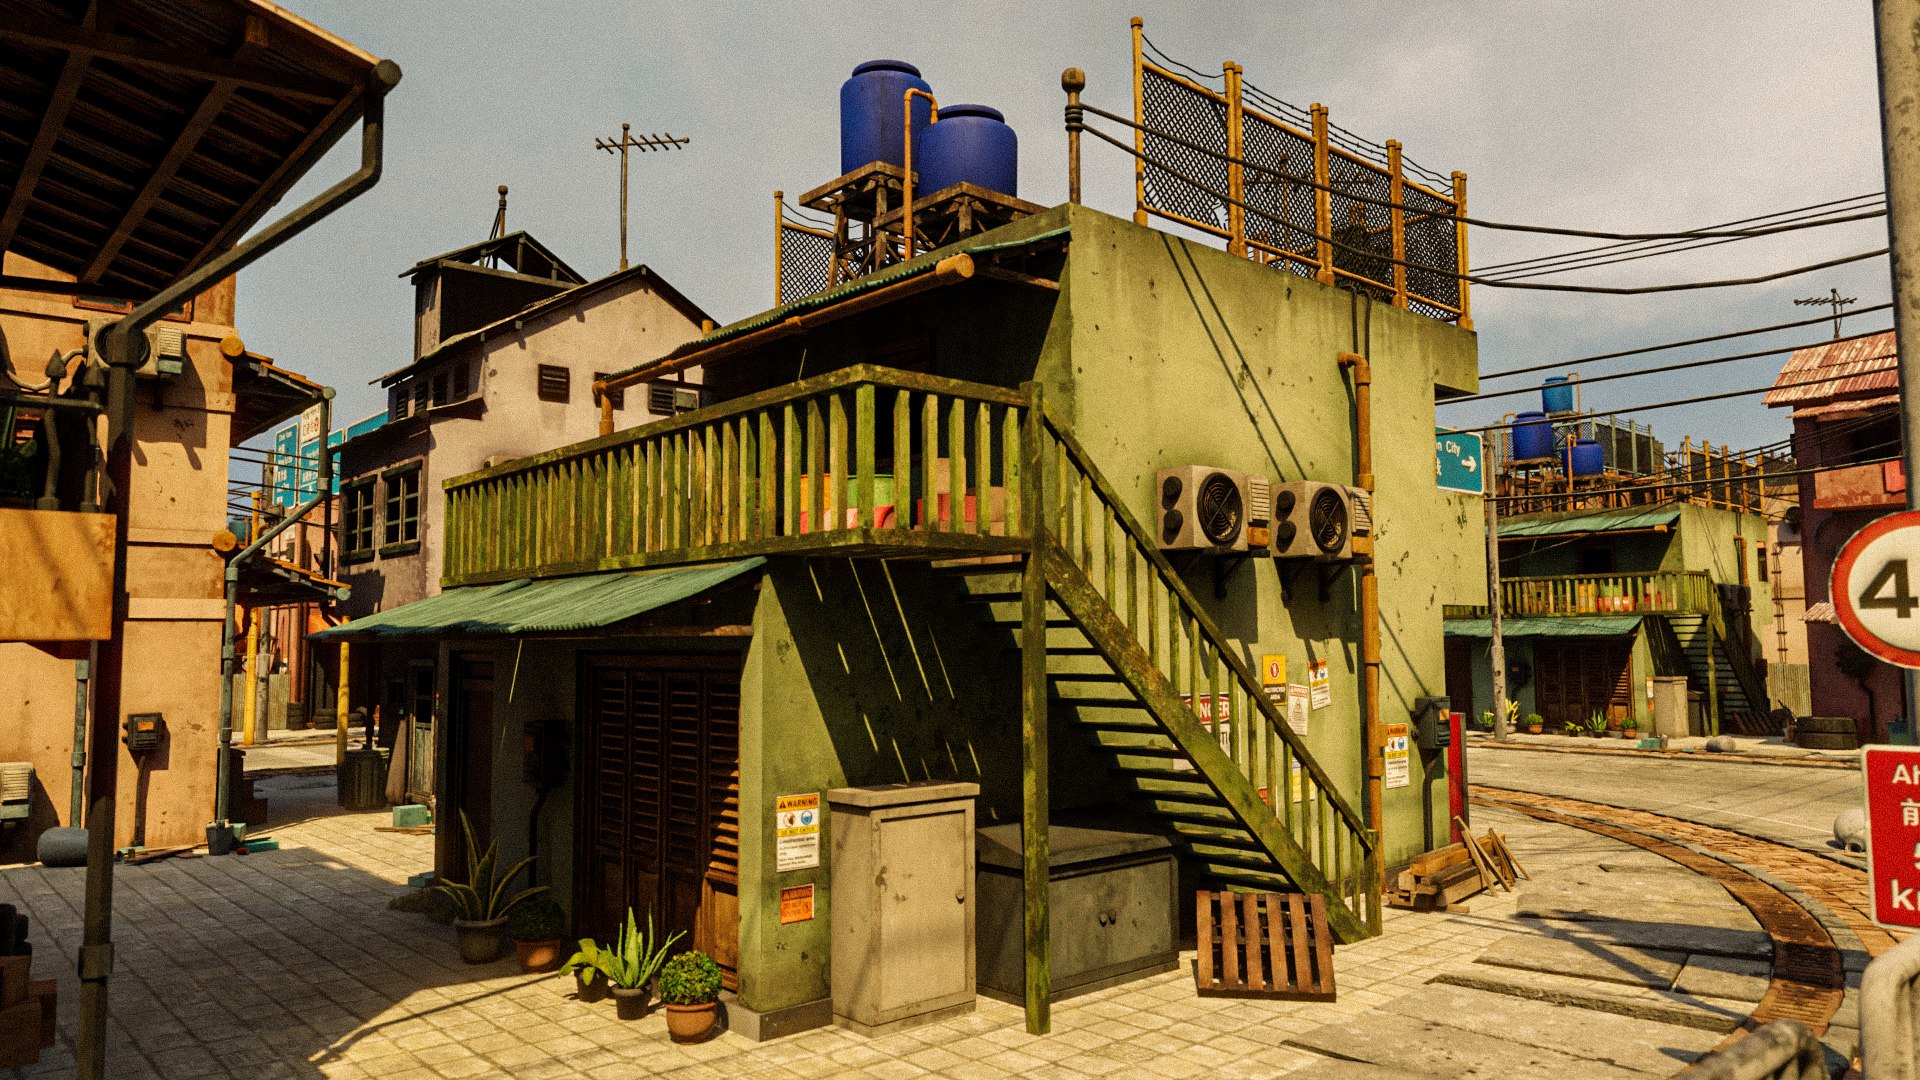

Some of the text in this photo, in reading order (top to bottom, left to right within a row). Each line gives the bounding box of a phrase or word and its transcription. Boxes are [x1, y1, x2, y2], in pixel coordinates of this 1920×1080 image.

[1446, 440, 1460, 457] City
[1859, 558, 1919, 618] 4
[787, 798, 818, 808] WARNING
